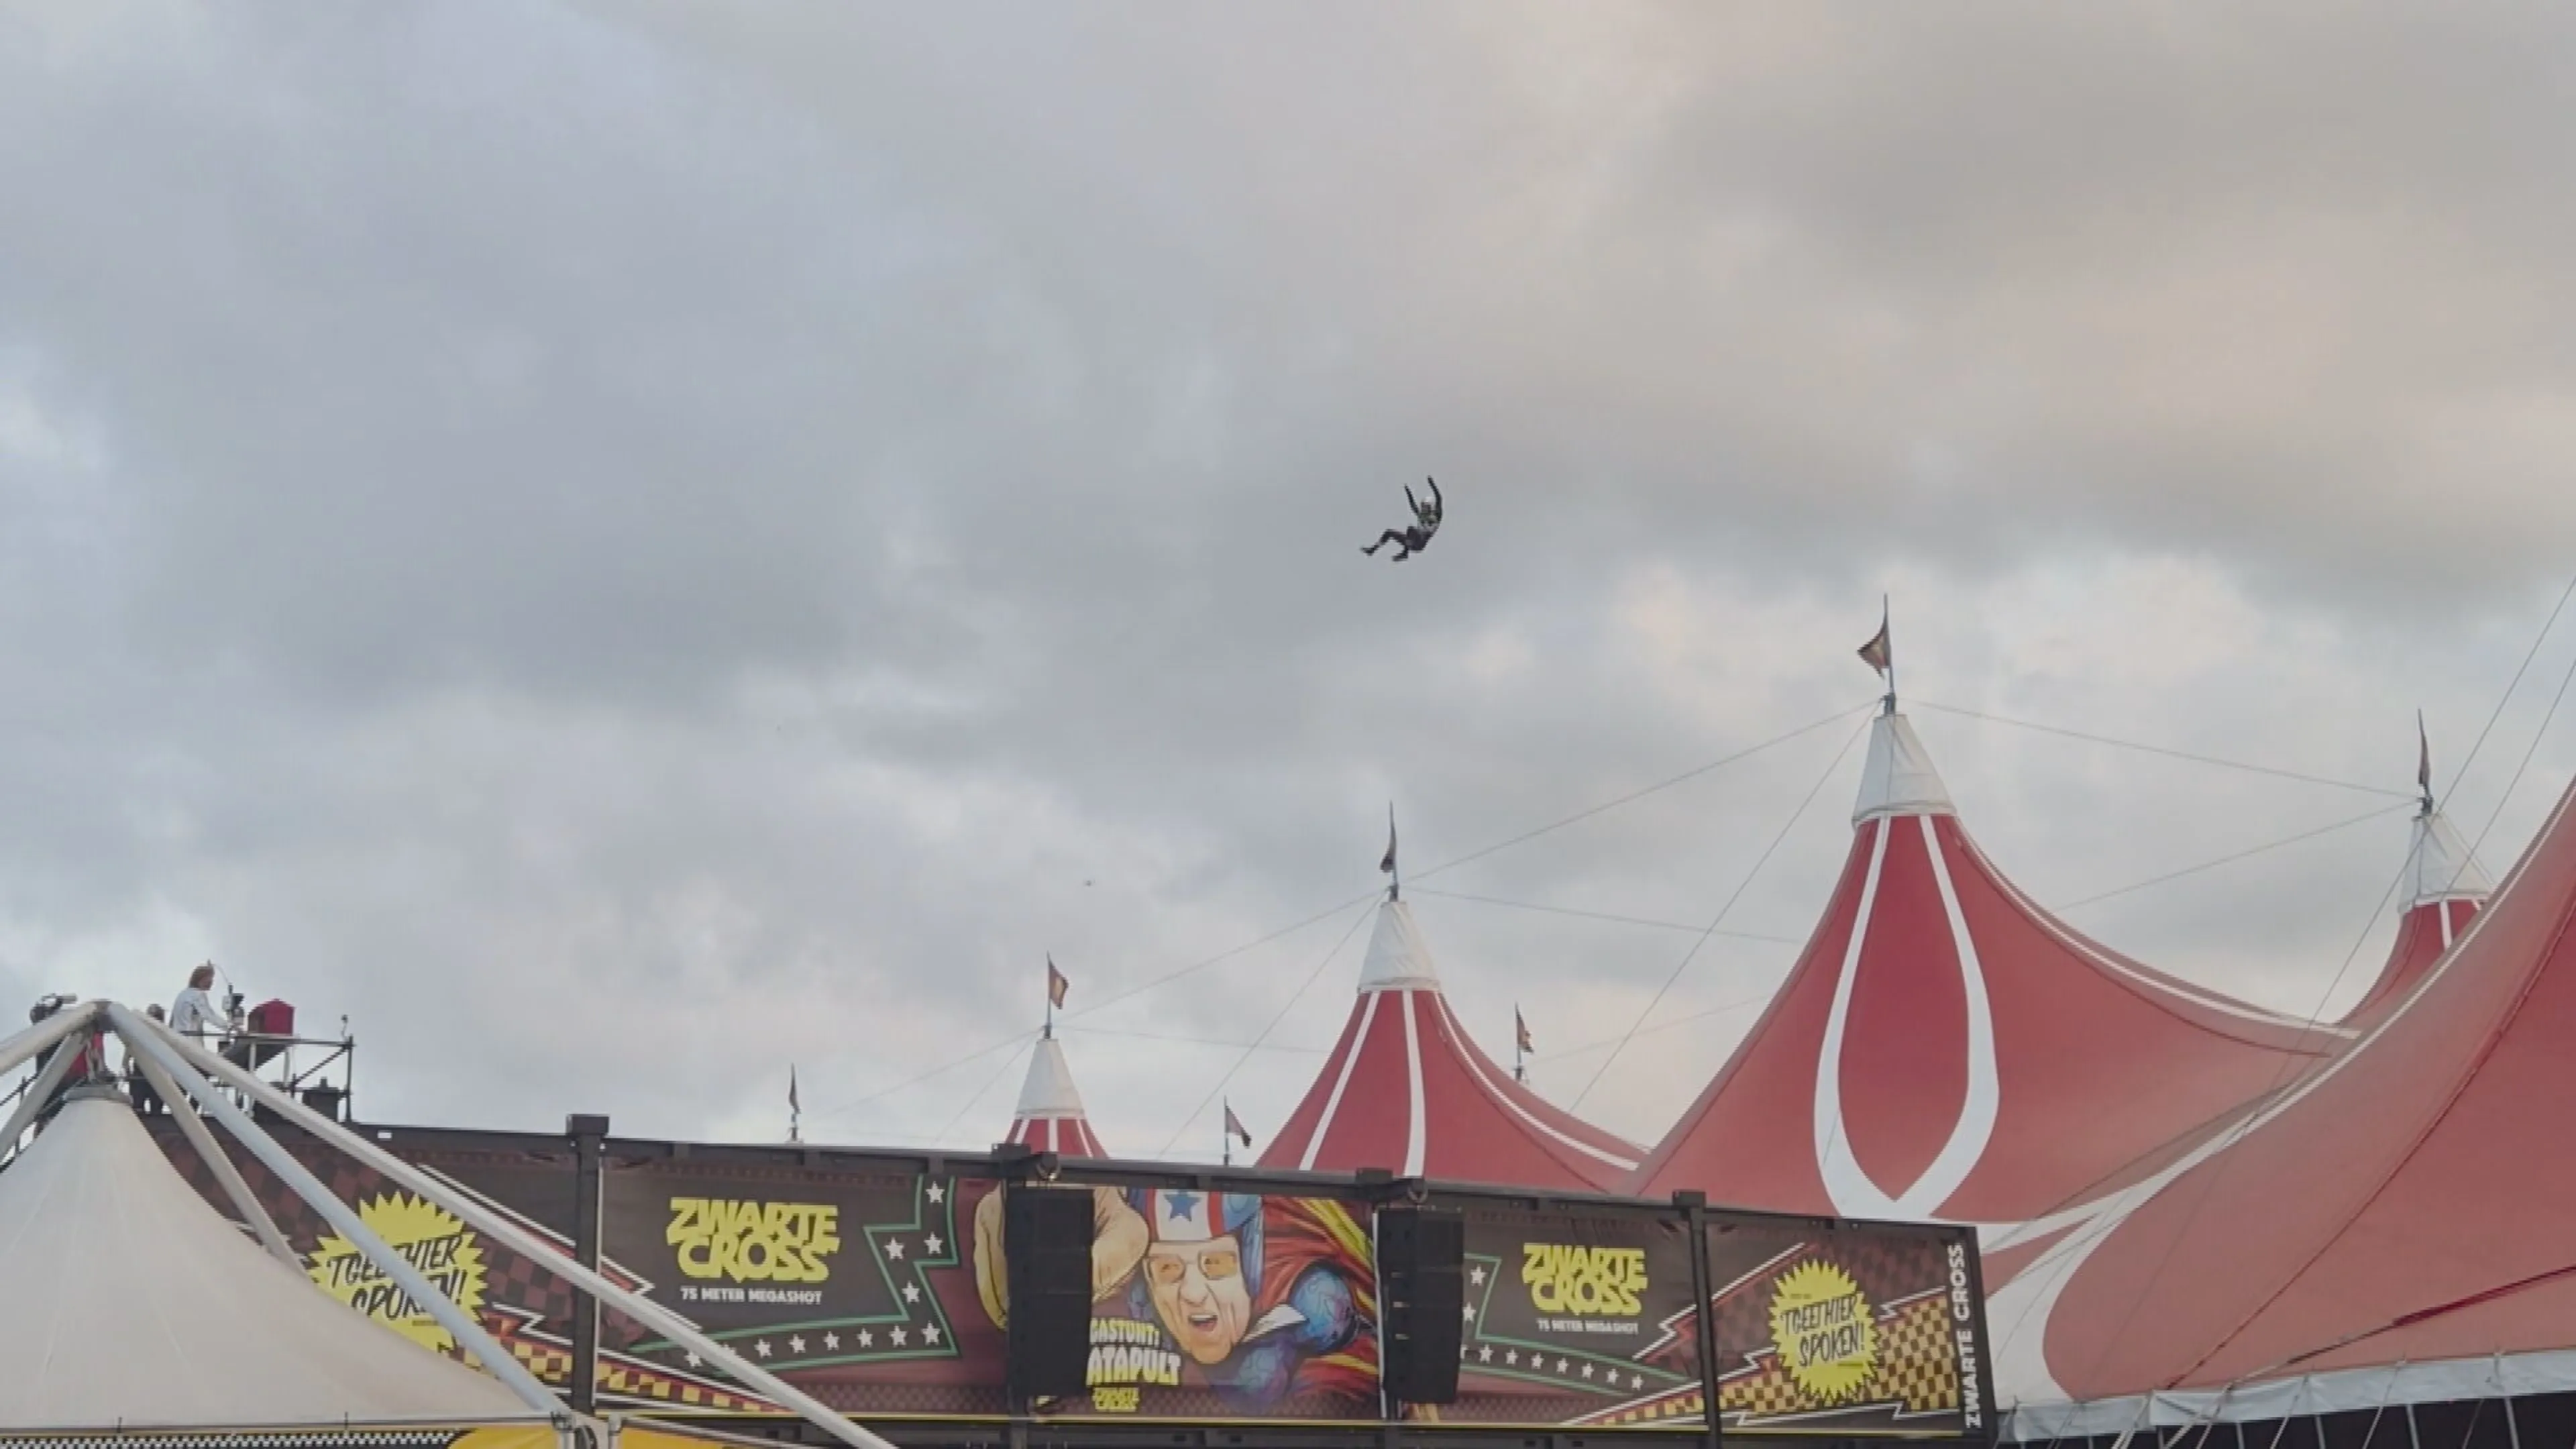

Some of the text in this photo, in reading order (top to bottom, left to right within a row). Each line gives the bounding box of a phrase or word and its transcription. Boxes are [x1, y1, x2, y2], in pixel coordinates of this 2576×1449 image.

[666, 1197, 840, 1254] ZWARTE
[678, 1234, 830, 1283] CROSS
[1522, 1243, 1648, 1290] ZWARTE
[680, 1286, 822, 1305] 75 METER MEGASHOT
[1532, 1275, 1642, 1316] CROSS
[1799, 1320, 1865, 1366] SPOKEN!
[1947, 1244, 1982, 1428] ZWARTE CROSS
